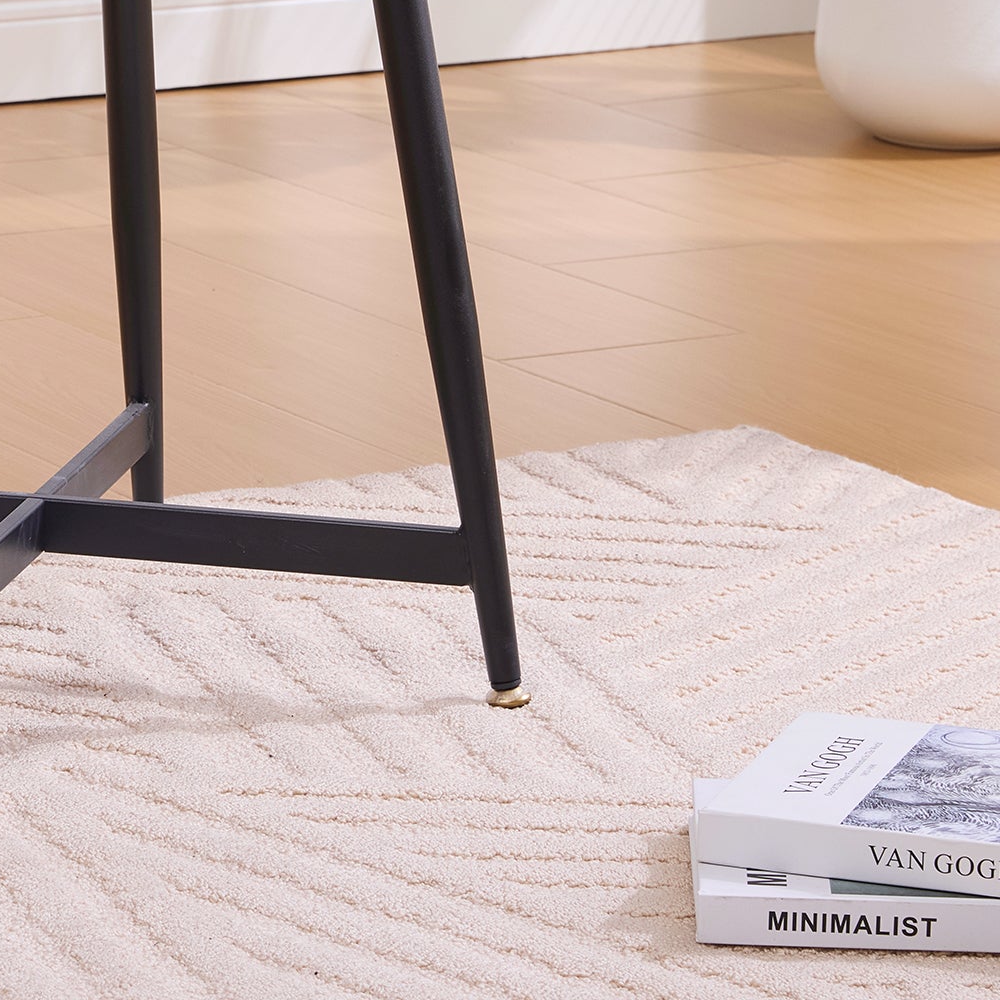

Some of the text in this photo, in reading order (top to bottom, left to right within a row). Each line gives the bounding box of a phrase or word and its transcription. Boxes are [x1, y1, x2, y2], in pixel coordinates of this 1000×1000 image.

[783, 769, 830, 793] VAN
[811, 736, 865, 769] GOGH
[746, 868, 787, 886] M
[868, 845, 1000, 880] VAN GOG
[768, 911, 938, 938] MINIMALIST
